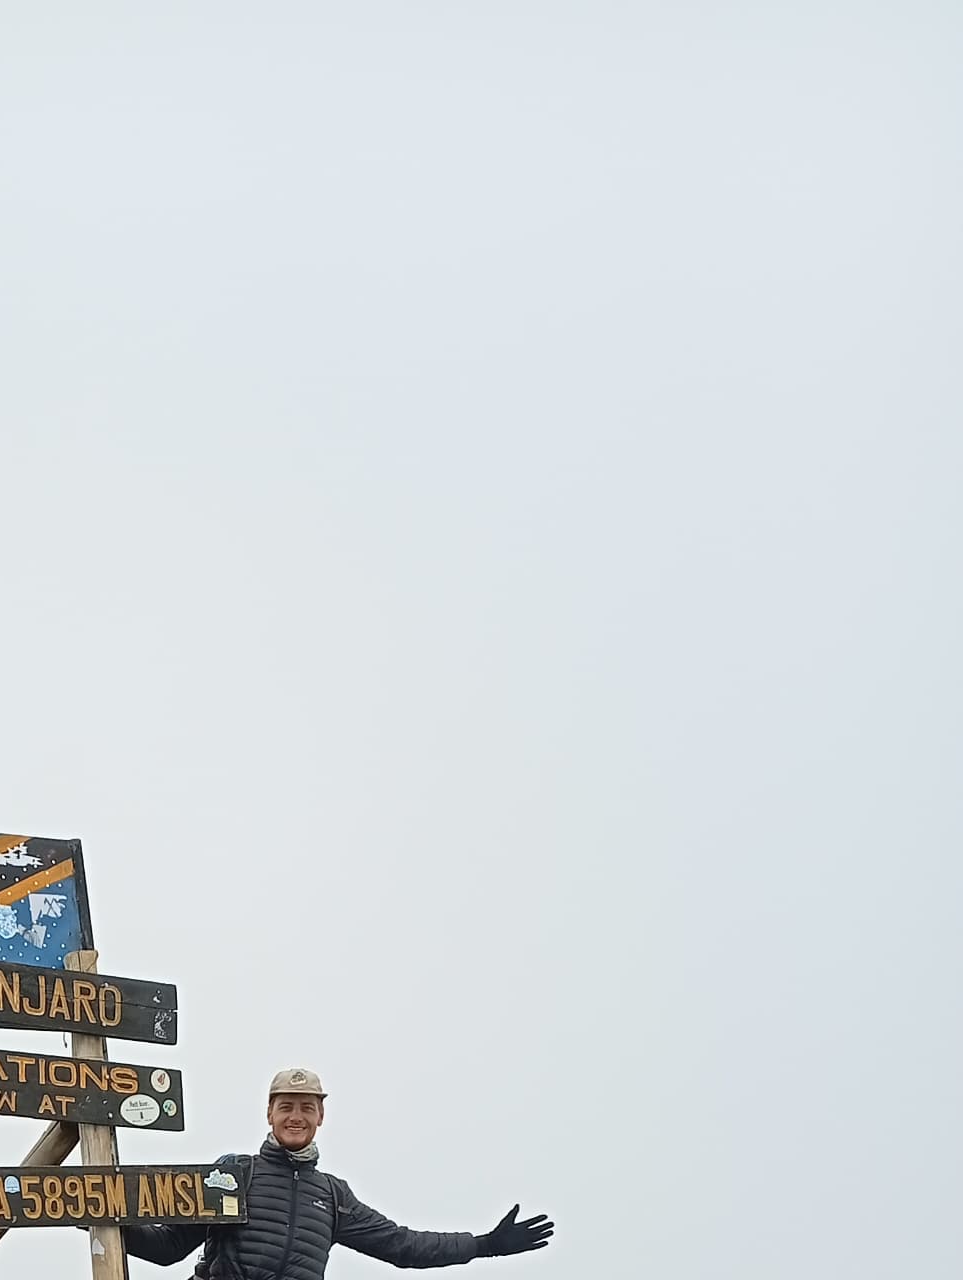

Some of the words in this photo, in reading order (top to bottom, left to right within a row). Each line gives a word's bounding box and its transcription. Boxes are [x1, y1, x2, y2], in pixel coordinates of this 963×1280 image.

[38, 1094, 76, 1117] AT
[20, 1174, 127, 1220] 5895M
[137, 1172, 216, 1218] AMSL
